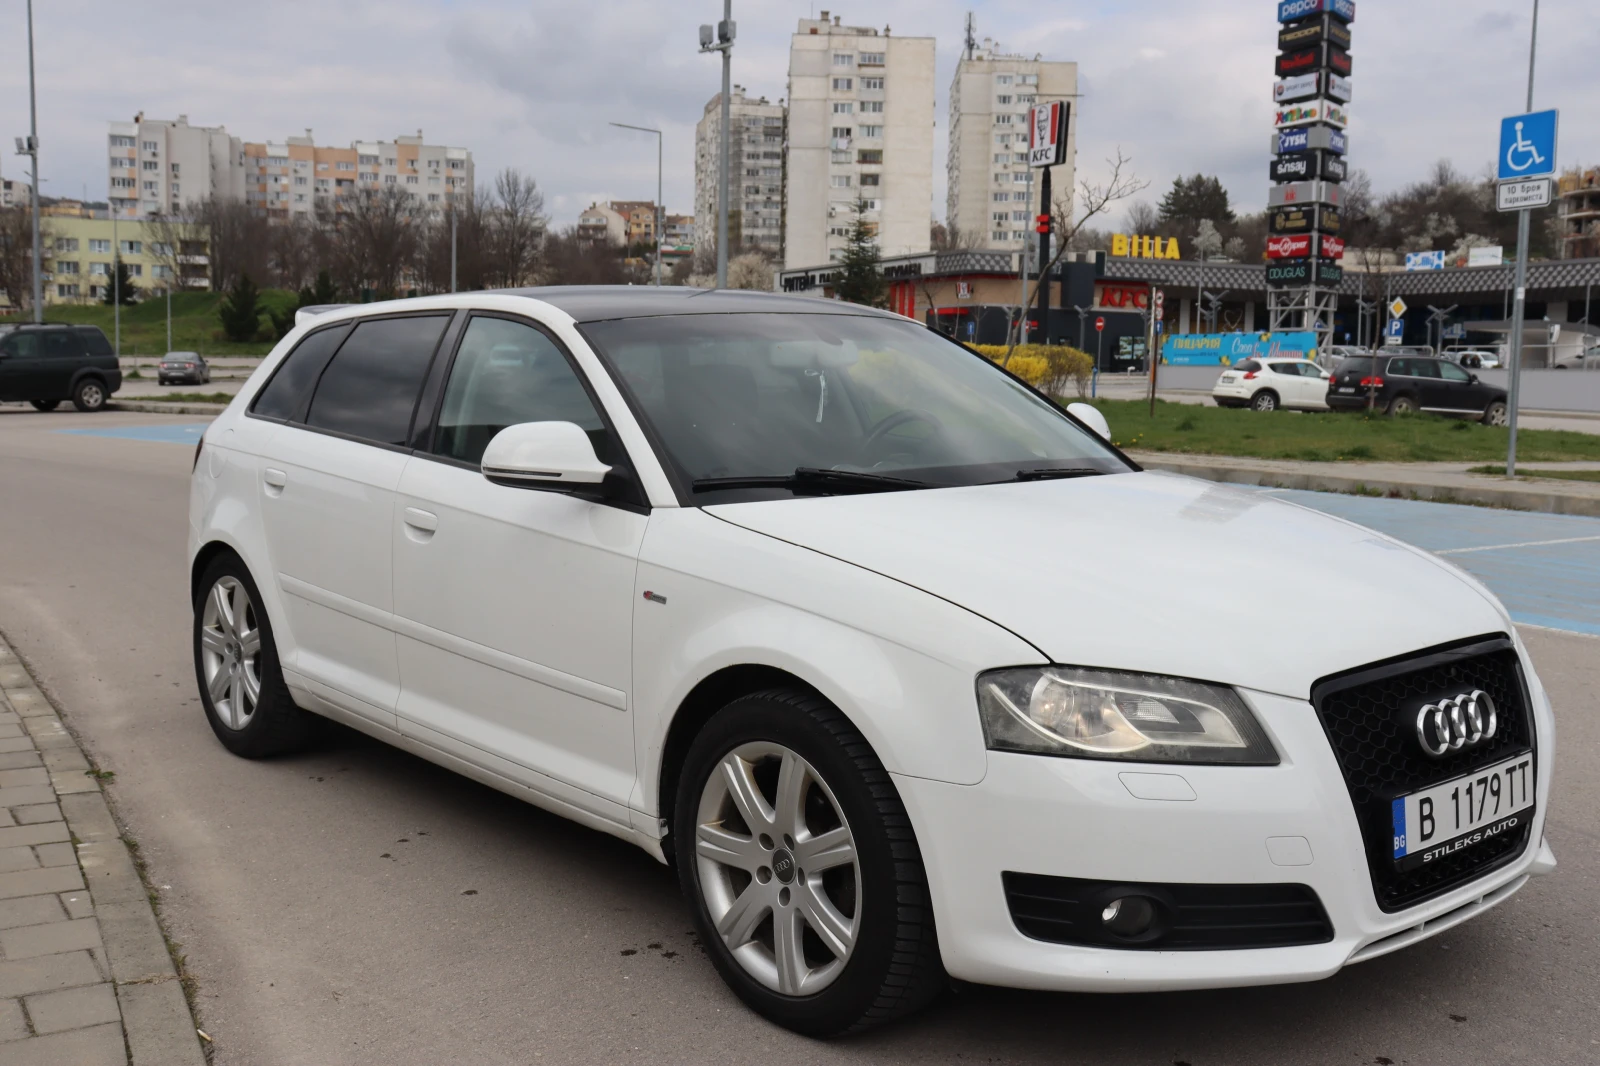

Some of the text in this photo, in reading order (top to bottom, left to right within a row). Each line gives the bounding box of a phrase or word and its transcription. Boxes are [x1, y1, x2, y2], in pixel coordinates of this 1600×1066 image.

[1282, 0, 1318, 18] pepco
[1284, 133, 1306, 147] JYSK
[1032, 148, 1051, 162] KFC
[1277, 160, 1306, 175] sinsay
[1507, 185, 1517, 194] 10
[1112, 233, 1180, 259] BILLA
[1269, 267, 1305, 279] DOUGLAS
[1099, 287, 1149, 309] KFC
[1391, 321, 1400, 334] P
[1173, 338, 1220, 350] ПИЦАРИЯ
[1419, 760, 1529, 843] B 1179 TT
[1394, 834, 1406, 850] BG
[1423, 817, 1518, 862] STILEKS AUTO
